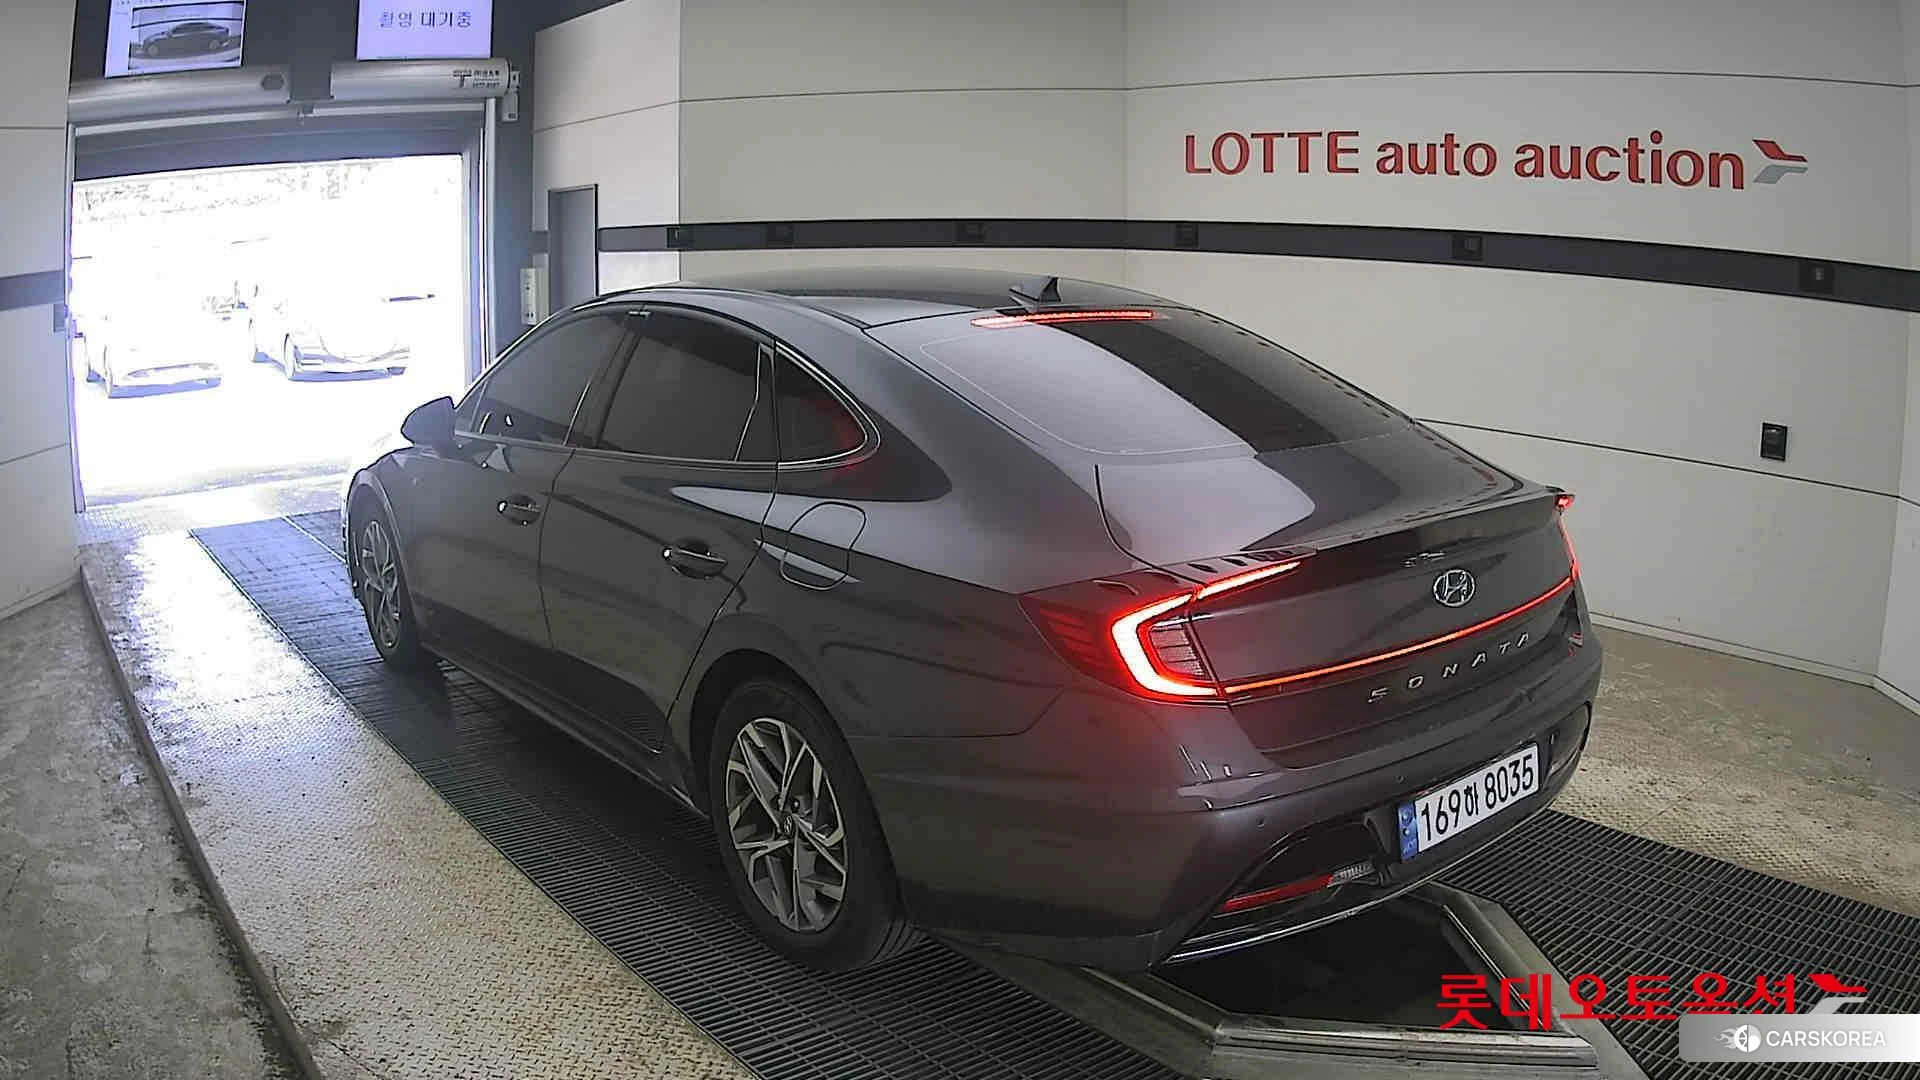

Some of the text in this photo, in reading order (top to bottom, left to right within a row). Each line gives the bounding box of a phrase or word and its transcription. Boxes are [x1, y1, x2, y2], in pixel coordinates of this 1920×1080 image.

[421, 11, 471, 28] 대기중
[1185, 130, 1744, 190] LOTTE auto auction
[1368, 633, 1529, 703] SONATA
[1421, 754, 1534, 841] 169하 8035
